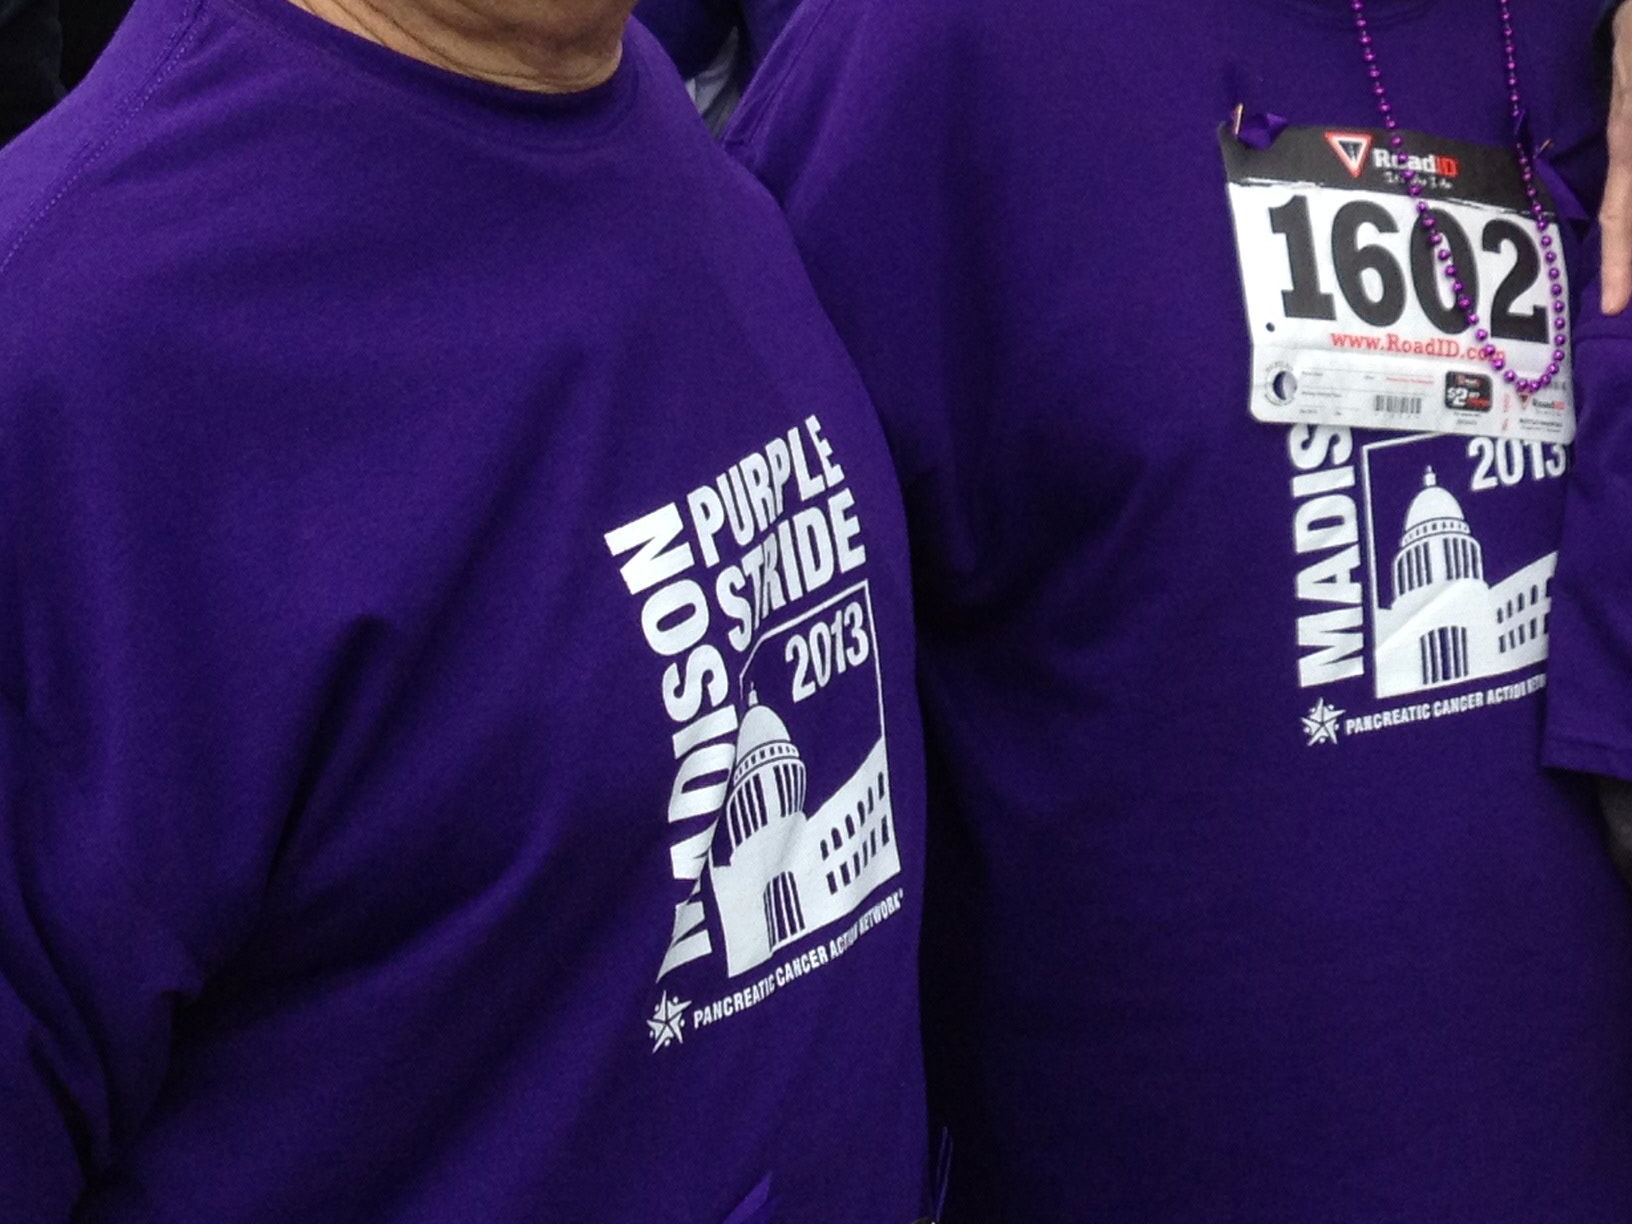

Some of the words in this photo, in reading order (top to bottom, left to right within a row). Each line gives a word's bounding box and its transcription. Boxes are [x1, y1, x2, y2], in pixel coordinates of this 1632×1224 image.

[1268, 194, 1550, 345] 1602
[686, 414, 845, 568] PURPLE
[1467, 436, 1567, 492] 2013
[715, 487, 867, 652] STRIDE
[784, 600, 869, 704] 2013
[1345, 702, 1431, 735] PANCREATIC
[1433, 690, 1484, 717] CANCER
[694, 973, 776, 1030] PANCREATIC
[774, 945, 829, 988] CANCER
